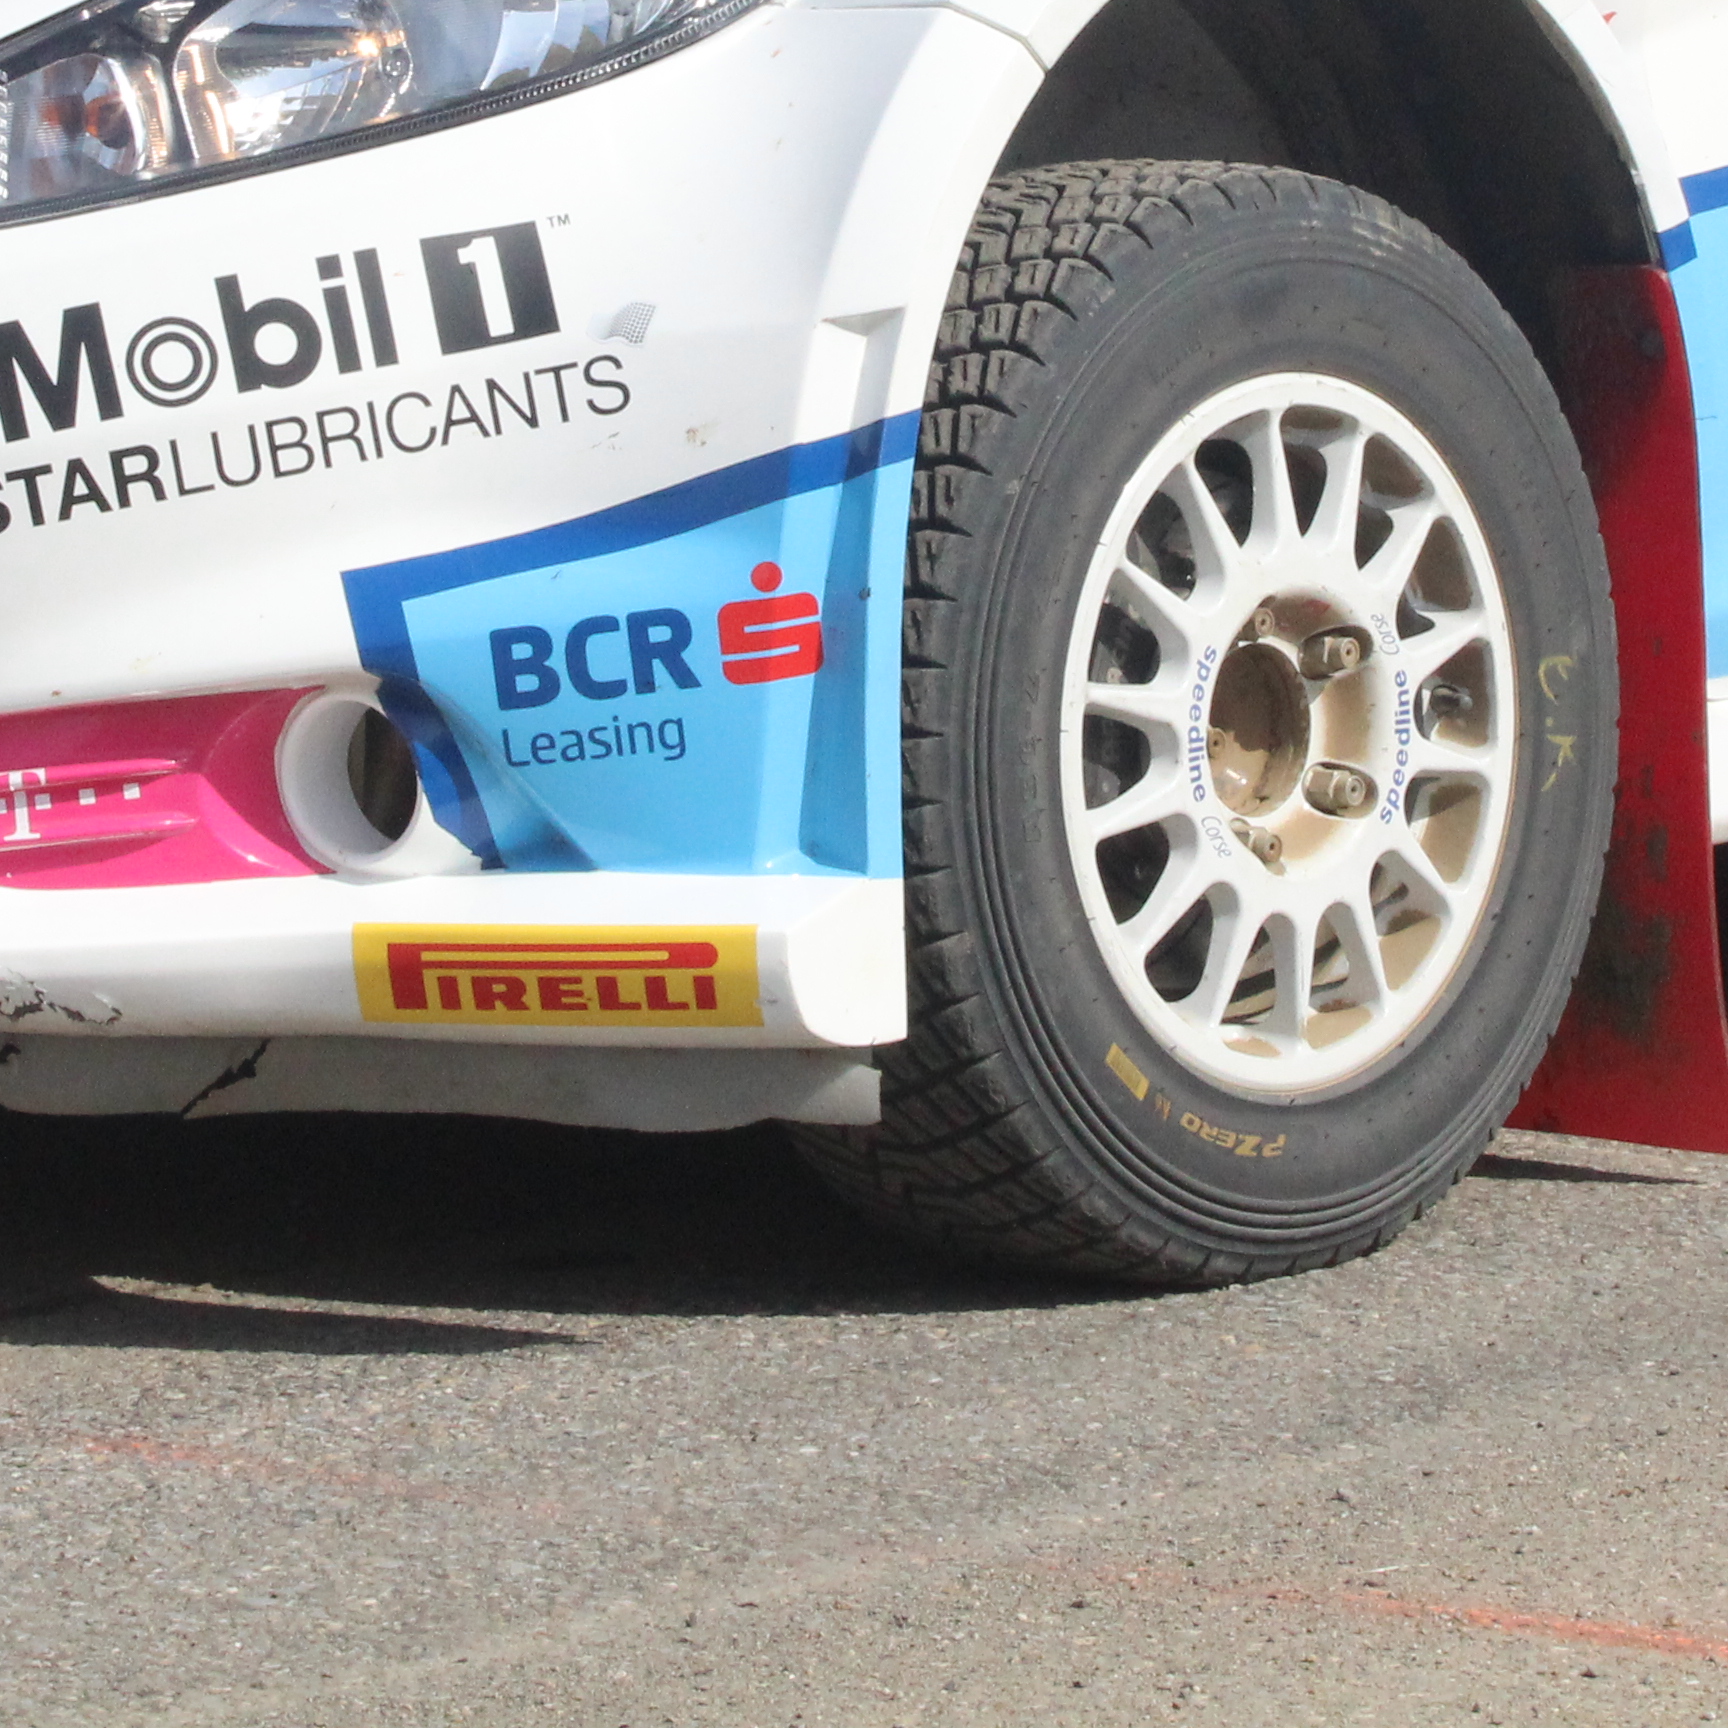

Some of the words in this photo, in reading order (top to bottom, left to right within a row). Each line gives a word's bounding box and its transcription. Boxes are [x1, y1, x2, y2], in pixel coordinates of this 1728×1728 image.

[488, 605, 703, 712] BCR
[1370, 612, 1400, 657] Corse
[501, 714, 688, 768] Leasing
[1187, 644, 1218, 804] speedline
[1379, 669, 1412, 826] speedline
[1200, 814, 1233, 859] Corse
[385, 941, 720, 1013] PIRELLI
